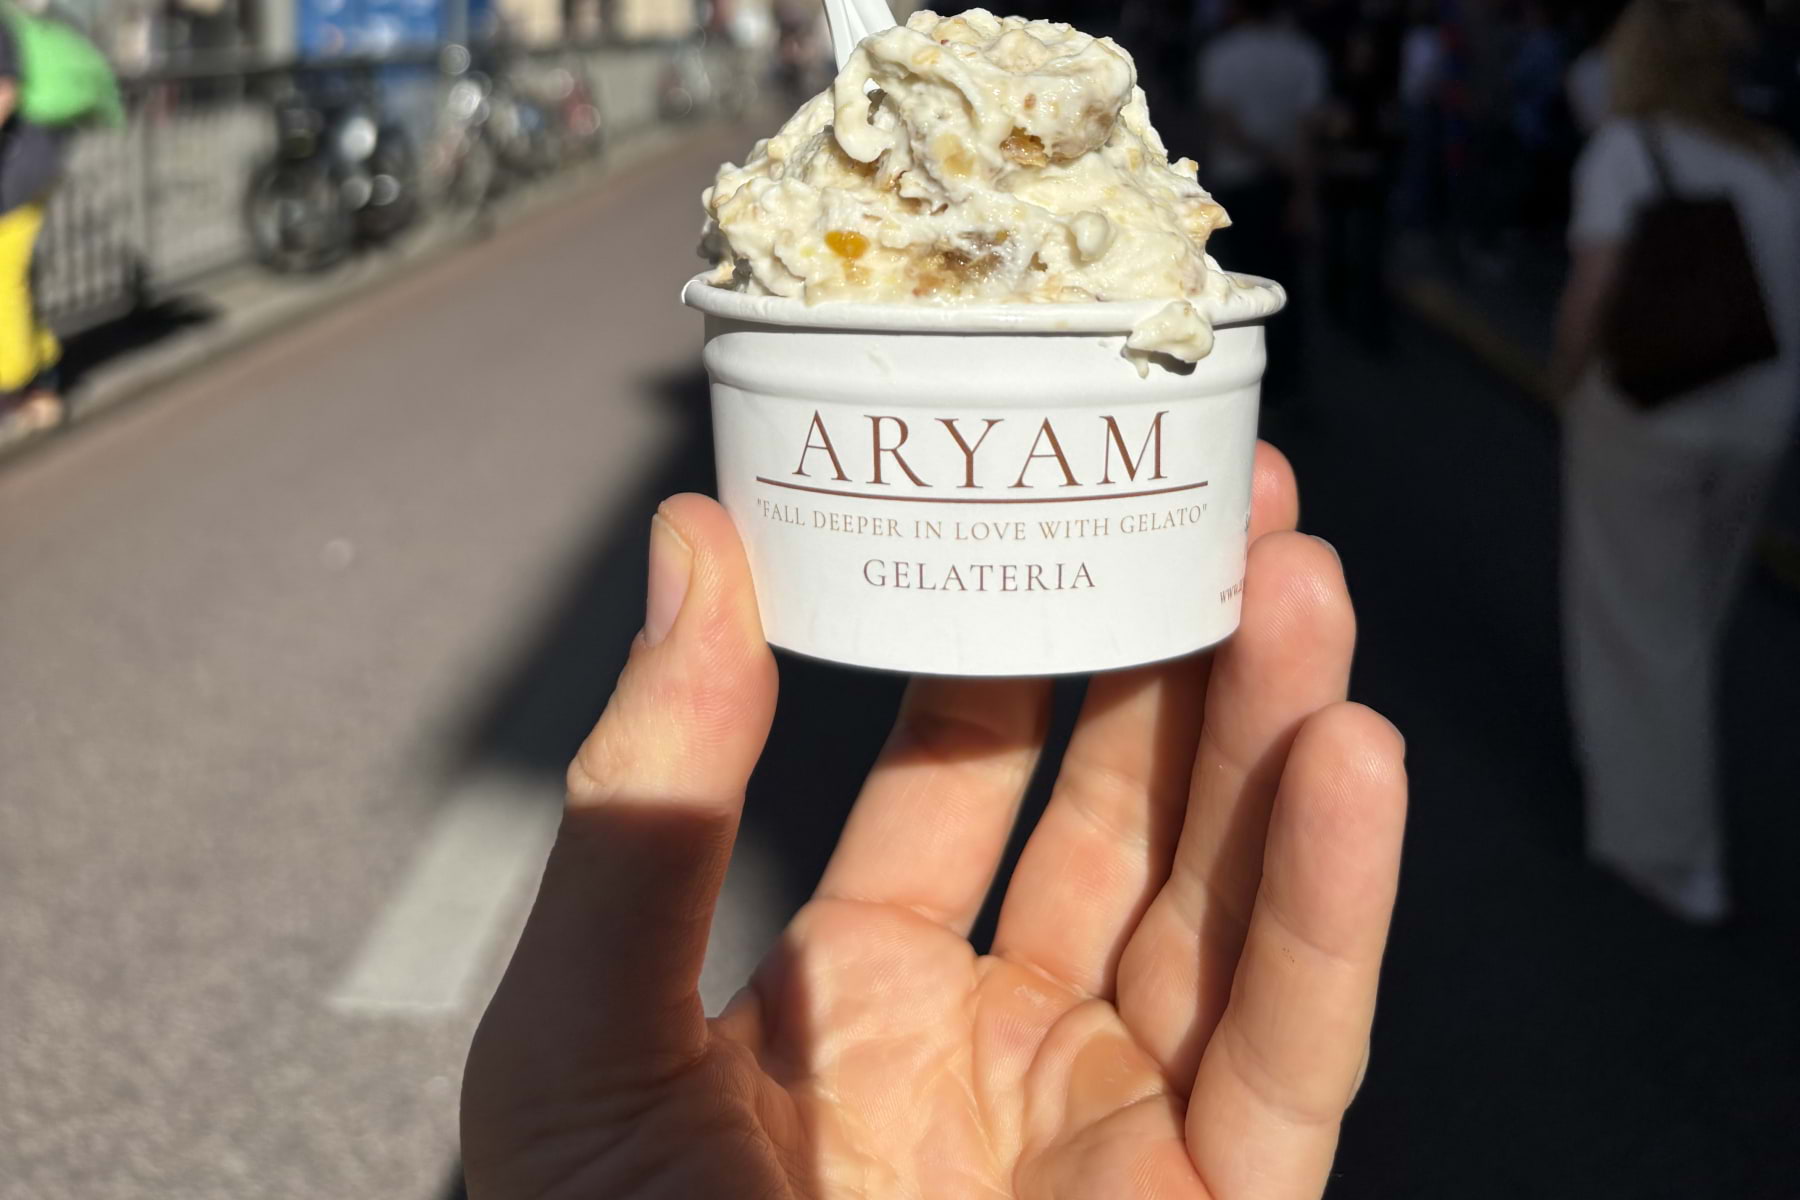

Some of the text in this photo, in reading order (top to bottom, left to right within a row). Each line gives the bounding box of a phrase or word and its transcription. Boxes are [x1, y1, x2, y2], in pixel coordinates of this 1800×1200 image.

[791, 409, 1169, 489] ARYAM
[757, 498, 1208, 541] "FALL DEEPER IN LOVE WITH GELATO"
[863, 558, 1096, 593] GELATERIA
